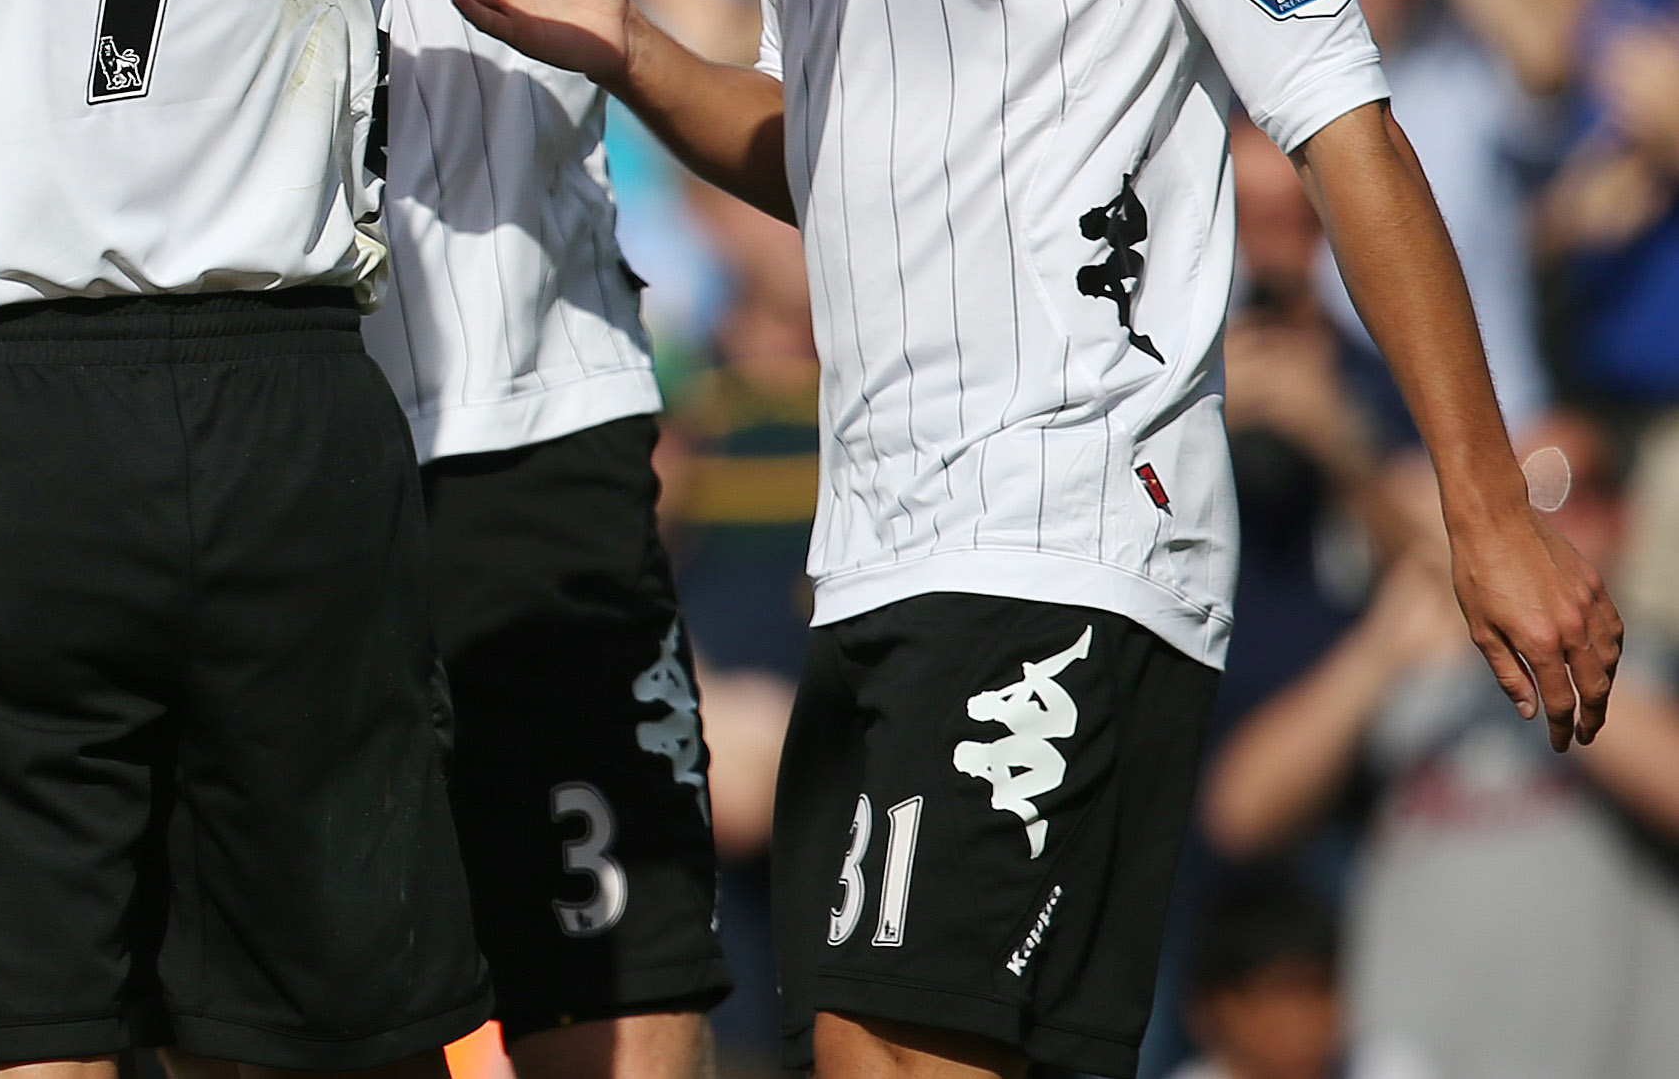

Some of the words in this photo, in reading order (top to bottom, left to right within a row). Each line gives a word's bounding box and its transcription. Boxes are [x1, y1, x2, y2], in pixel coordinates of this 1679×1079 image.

[549, 781, 629, 937] 3
[827, 793, 924, 947] 31
[1005, 885, 1063, 977] Kappa
